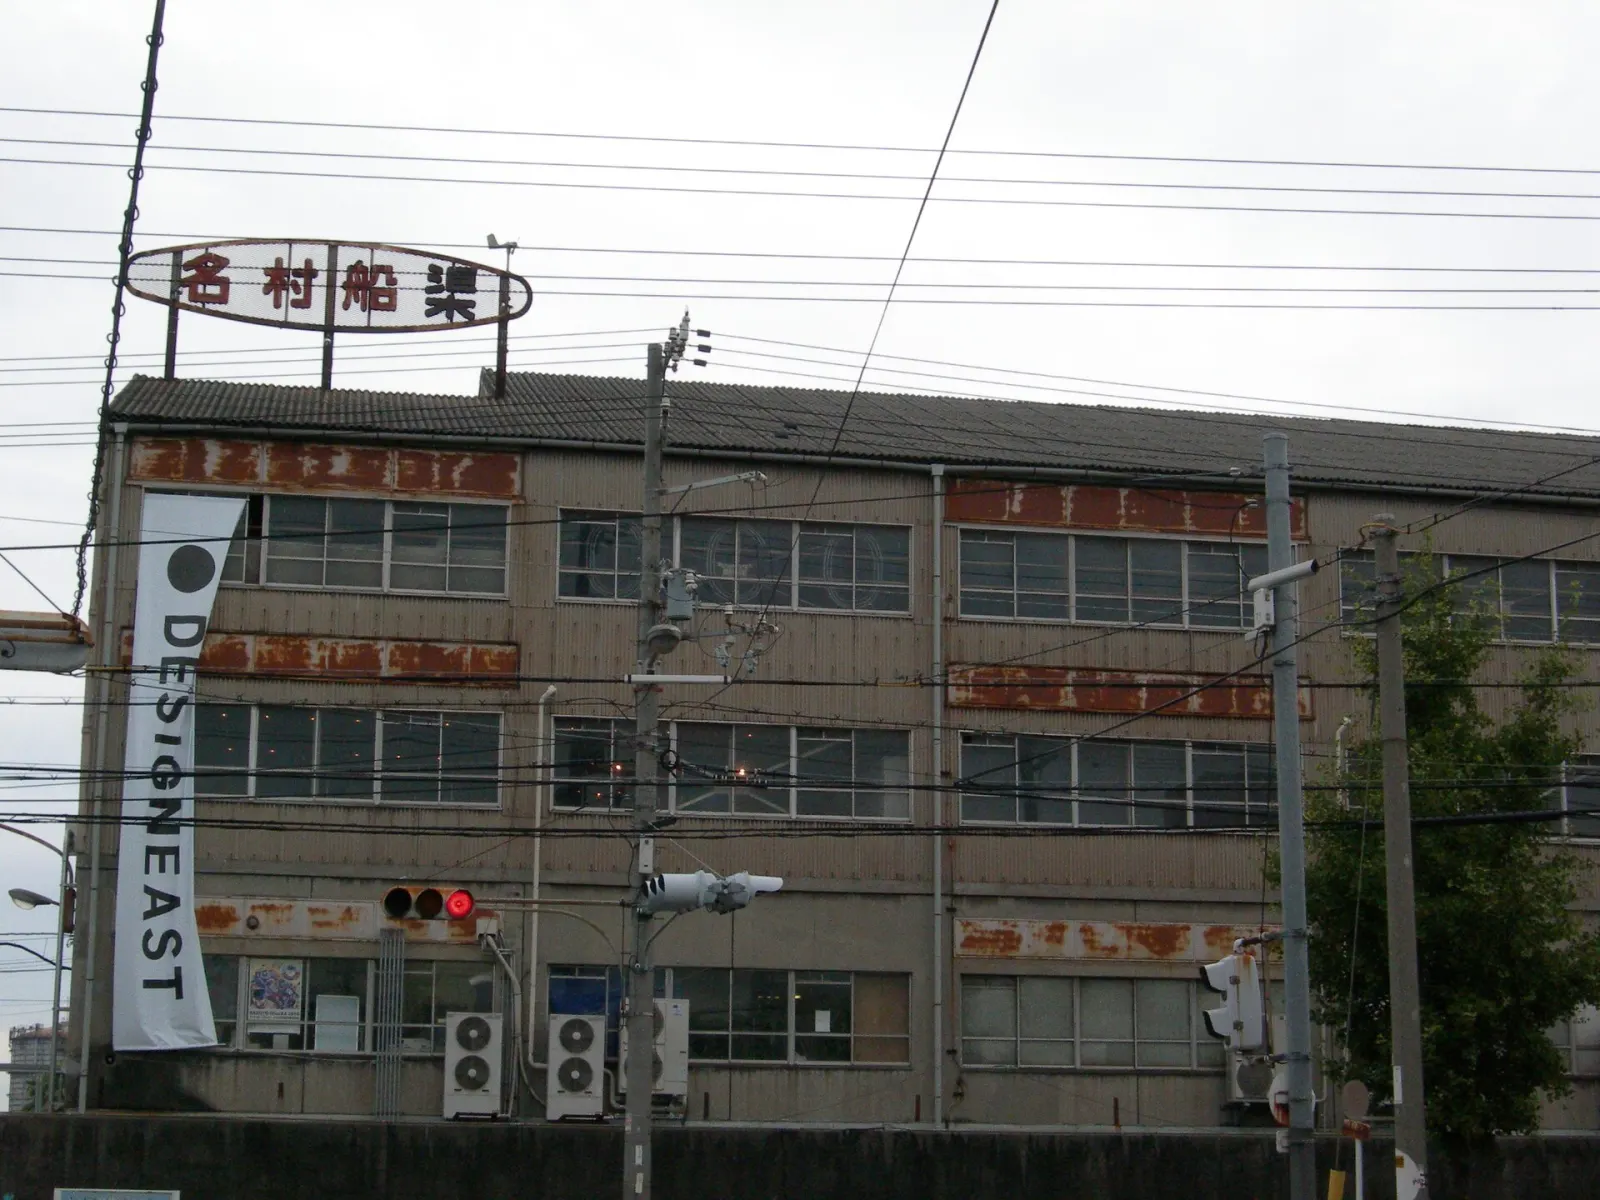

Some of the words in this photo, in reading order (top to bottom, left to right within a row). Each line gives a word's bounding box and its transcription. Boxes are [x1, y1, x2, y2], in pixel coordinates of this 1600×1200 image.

[180, 252, 478, 321] 名村船渠
[142, 615, 207, 1000] DESIGNEAST
